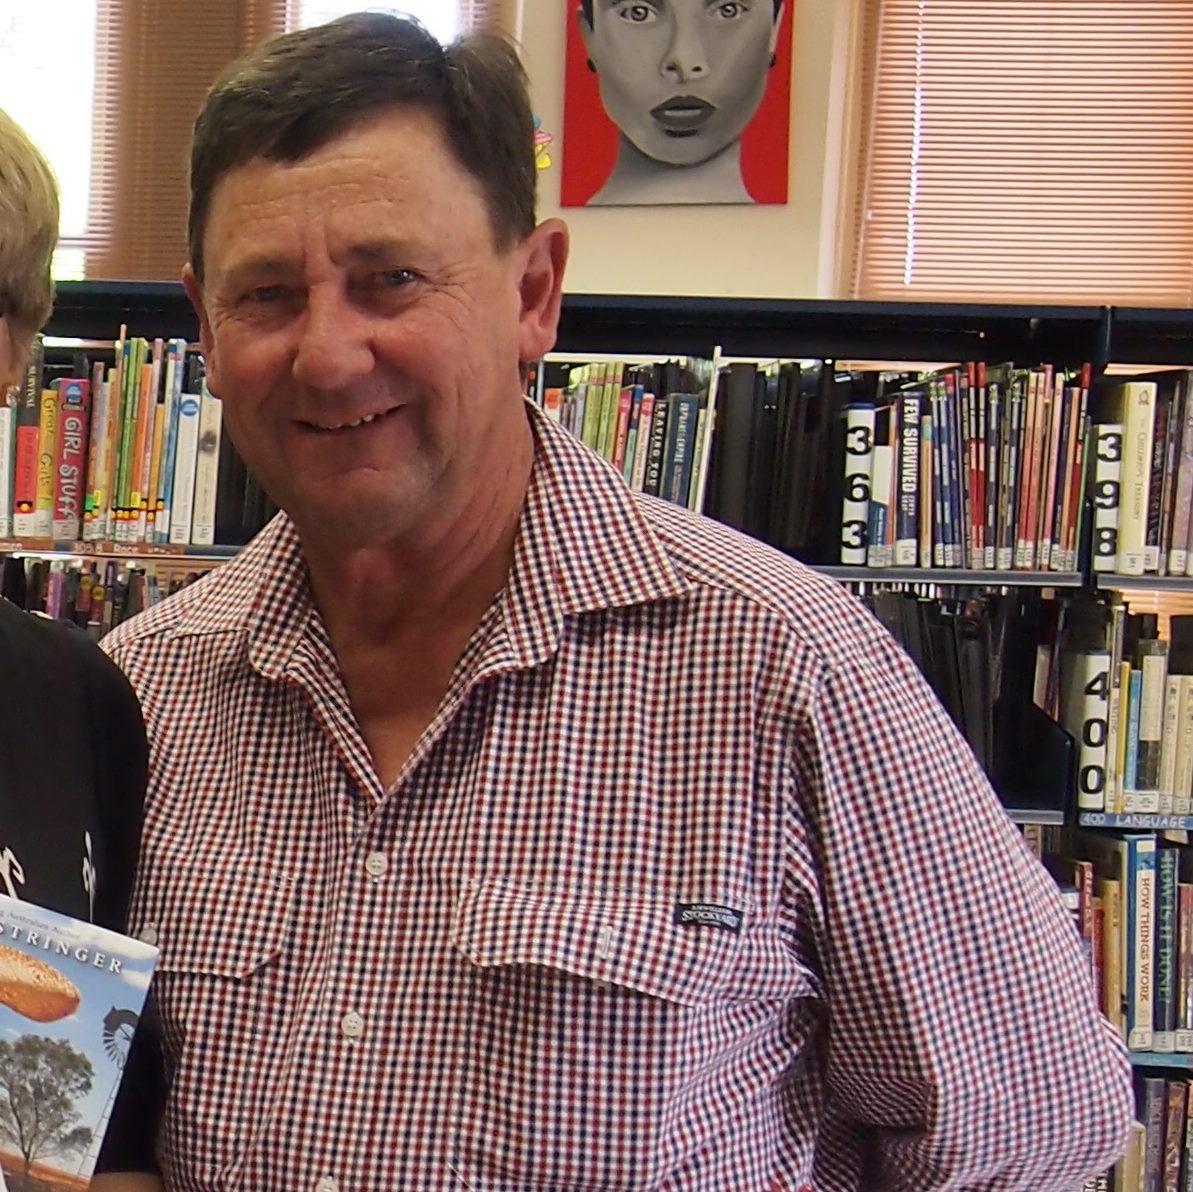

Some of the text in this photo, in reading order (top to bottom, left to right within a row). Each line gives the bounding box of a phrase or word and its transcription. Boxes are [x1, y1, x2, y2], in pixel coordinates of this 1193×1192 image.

[56, 416, 83, 522] GIRL STUFF
[648, 402, 667, 487] LEAVING YOU
[901, 399, 919, 493] FEW SURVIVED
[1079, 671, 1109, 795] 400
[1115, 814, 1186, 828] LANGUAGE
[1159, 854, 1174, 897] HOW
[1159, 904, 1173, 918] IS
[1139, 877, 1150, 1002] HOW THINGS WORK
[1159, 925, 1173, 939] IT
